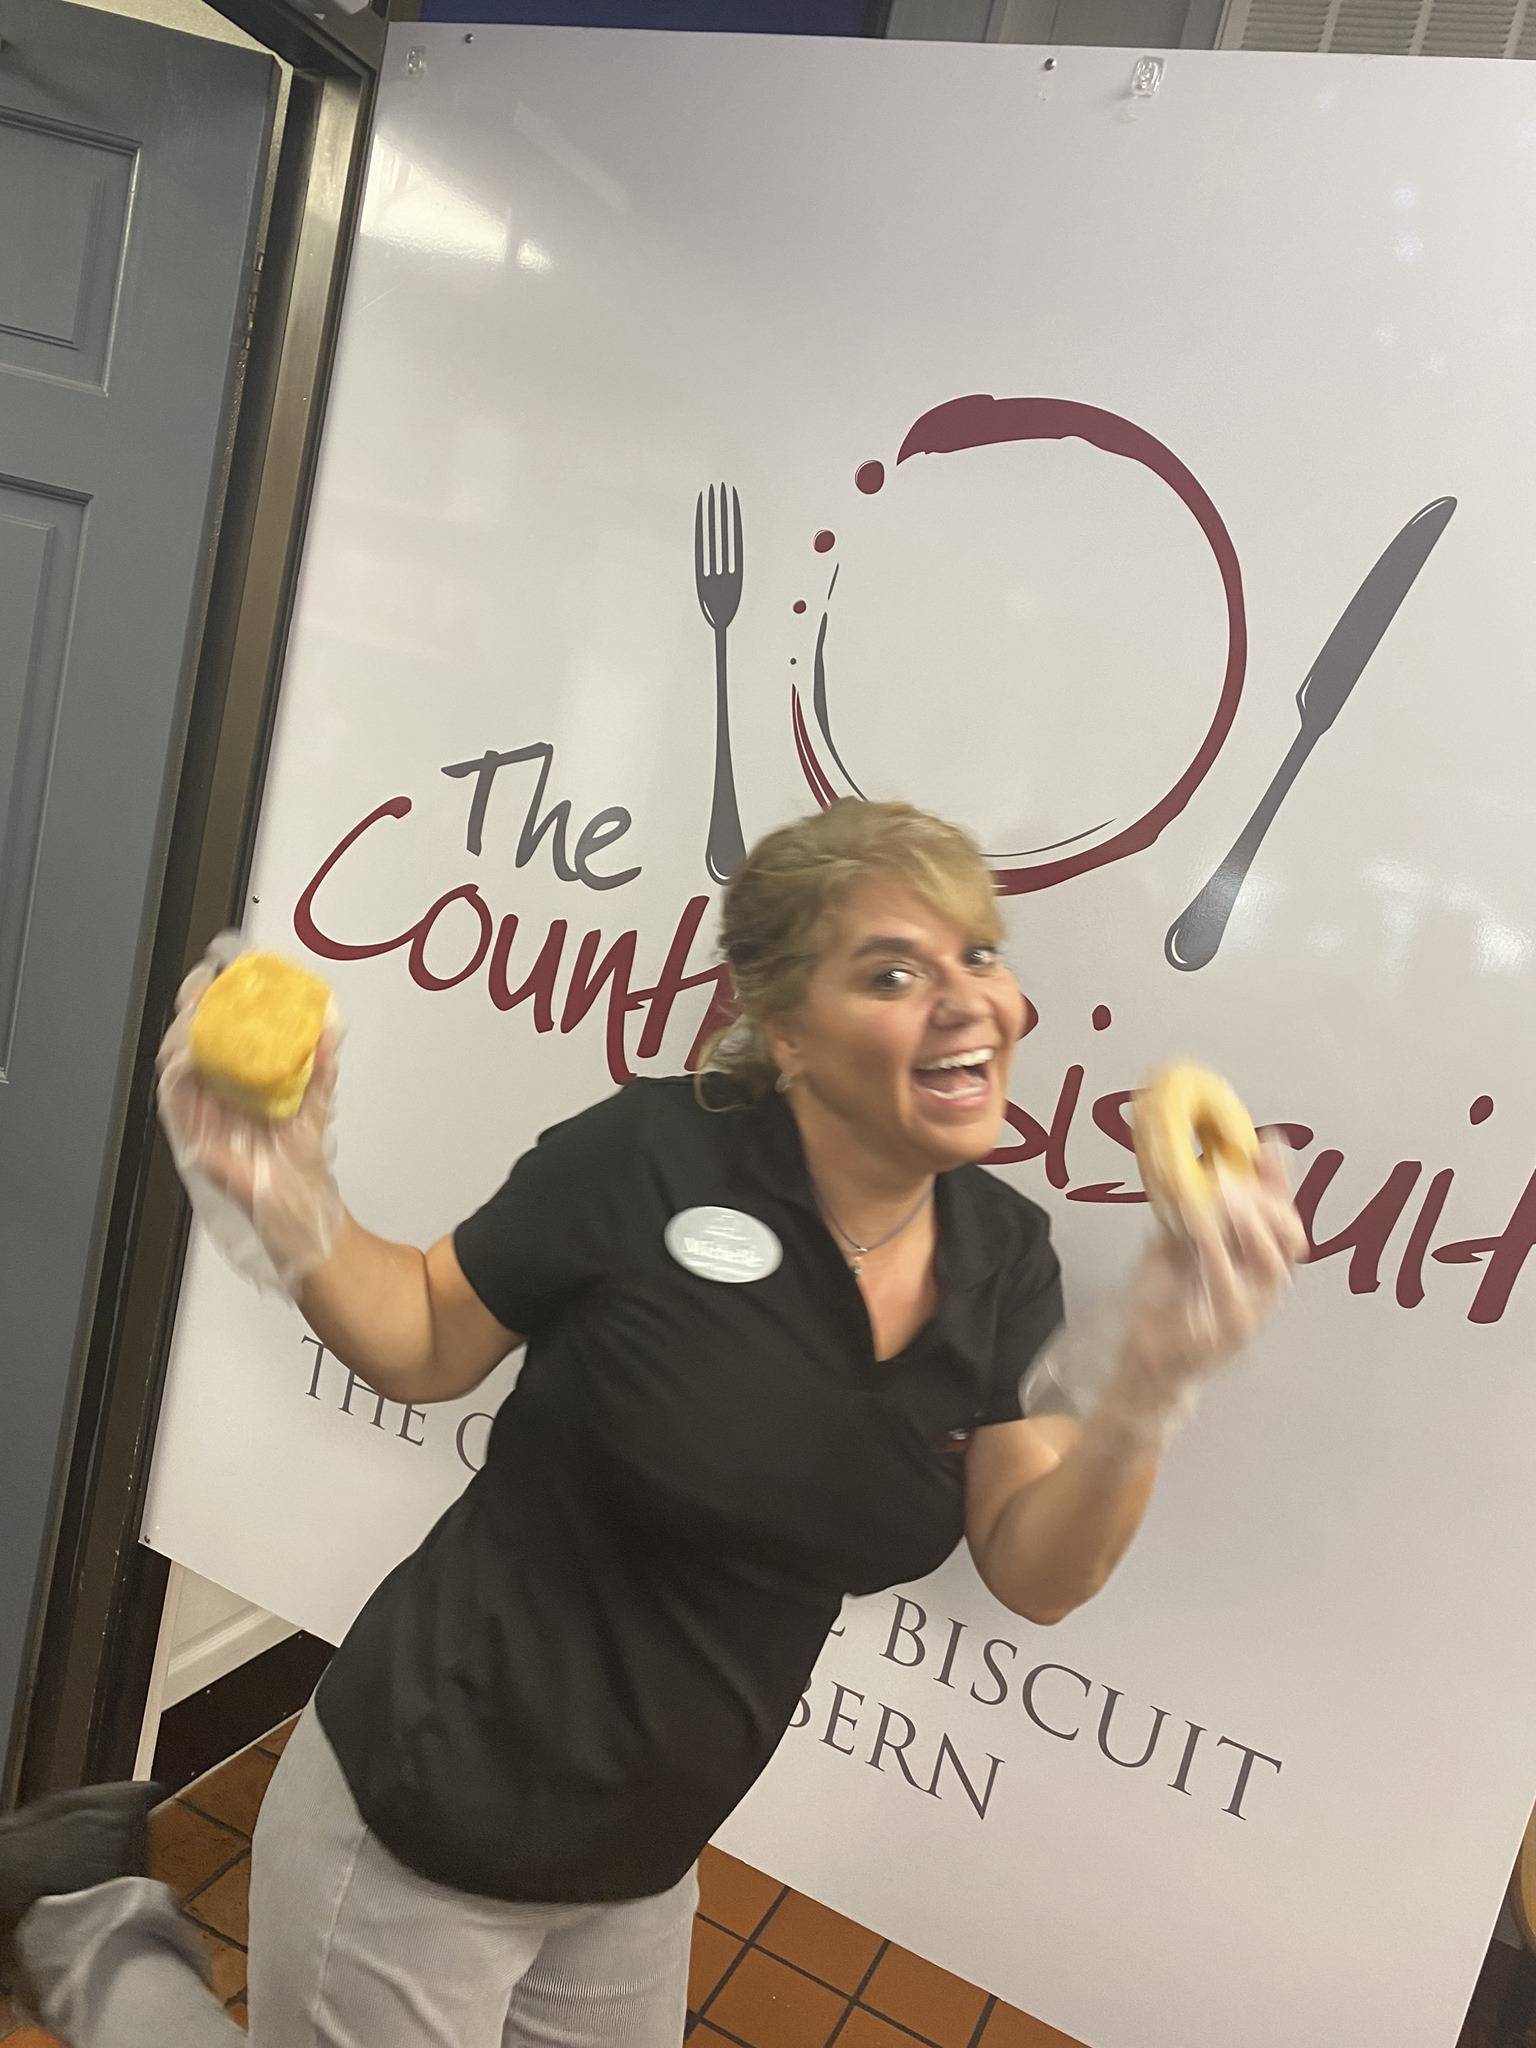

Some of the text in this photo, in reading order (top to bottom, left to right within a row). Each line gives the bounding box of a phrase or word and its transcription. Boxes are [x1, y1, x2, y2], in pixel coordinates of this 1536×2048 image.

[441, 741, 643, 891] The
[293, 796, 1536, 1324] Count isuit
[301, 1334, 427, 1447] THE
[878, 1592, 1283, 1821] BISCUIT
